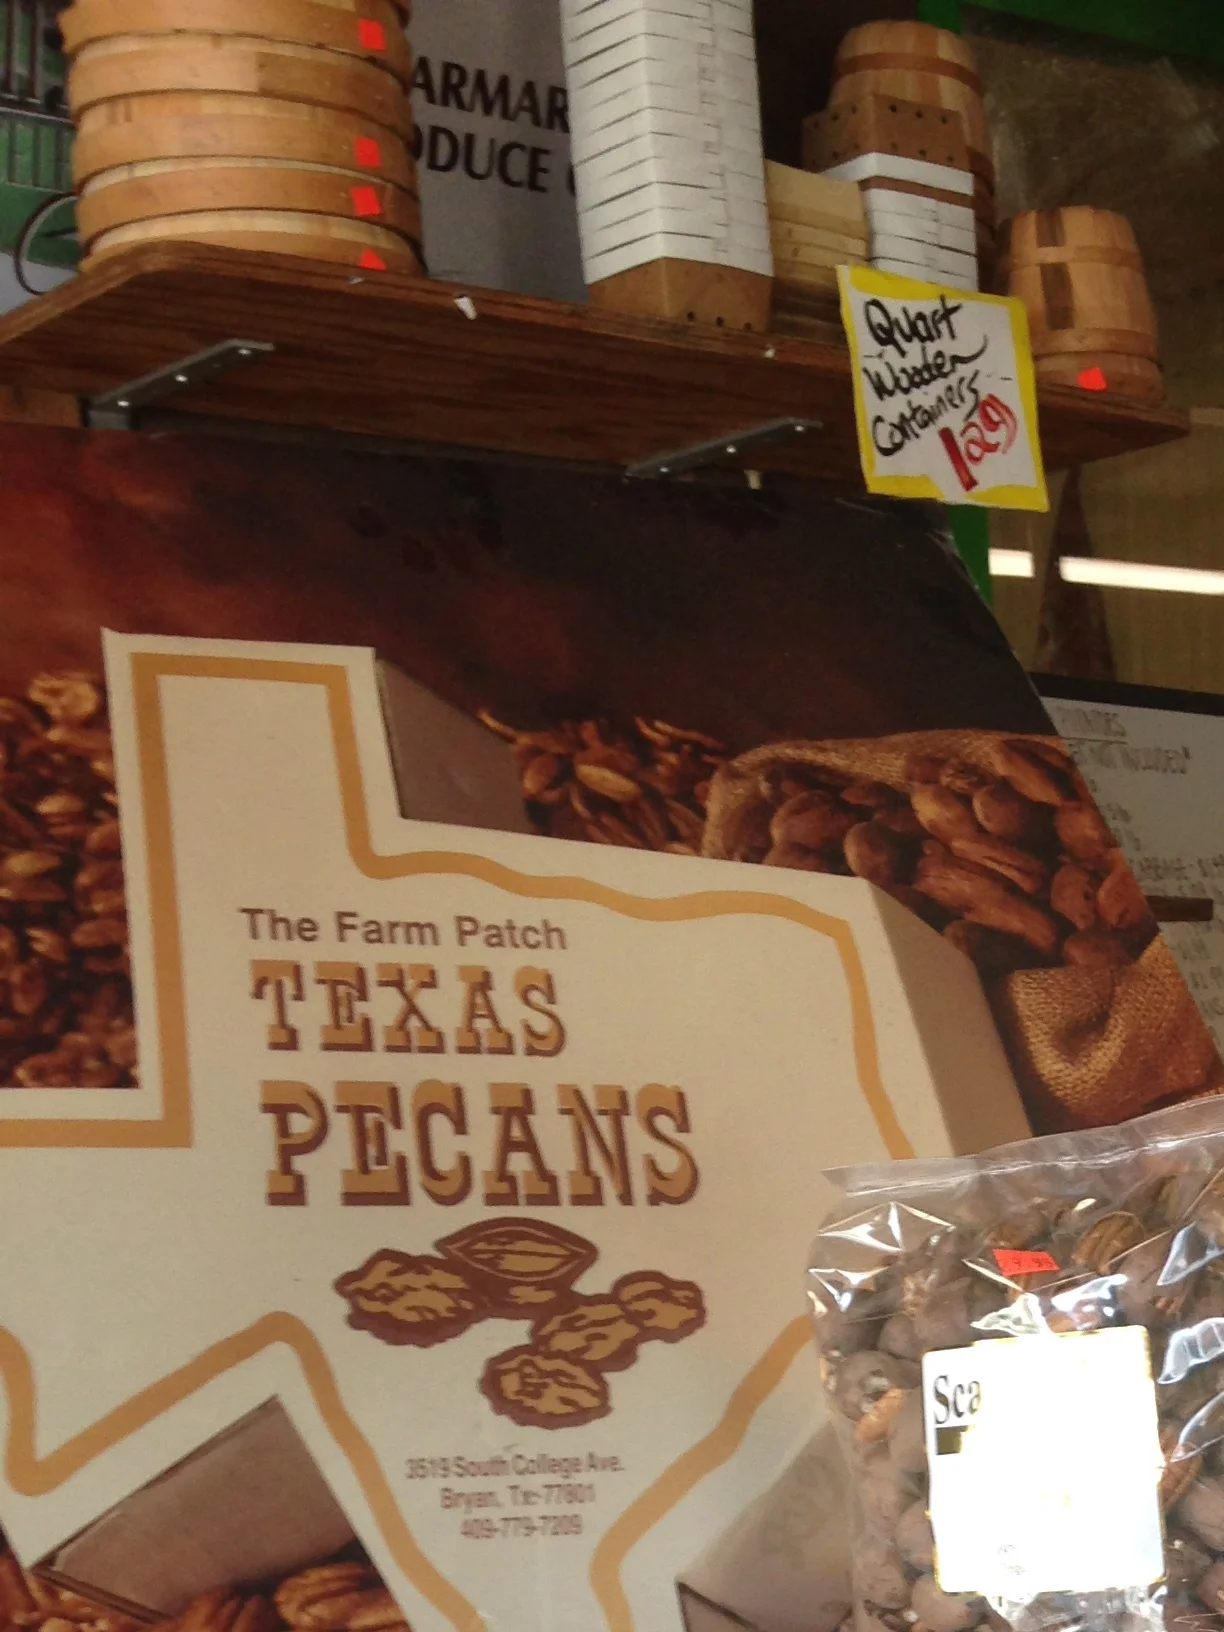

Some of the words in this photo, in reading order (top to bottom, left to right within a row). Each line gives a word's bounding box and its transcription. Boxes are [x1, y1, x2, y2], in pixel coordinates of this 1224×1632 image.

[411, 56, 570, 133] ARMAR
[863, 294, 962, 357] Quart
[862, 334, 988, 401] Wooden
[871, 369, 982, 457] Containers
[239, 907, 319, 943] The
[335, 910, 440, 946] Farm
[454, 914, 568, 951] Patch
[249, 959, 567, 1058] TEXAS
[258, 1078, 701, 1207] PECANS
[933, 1374, 981, 1425] Sca
